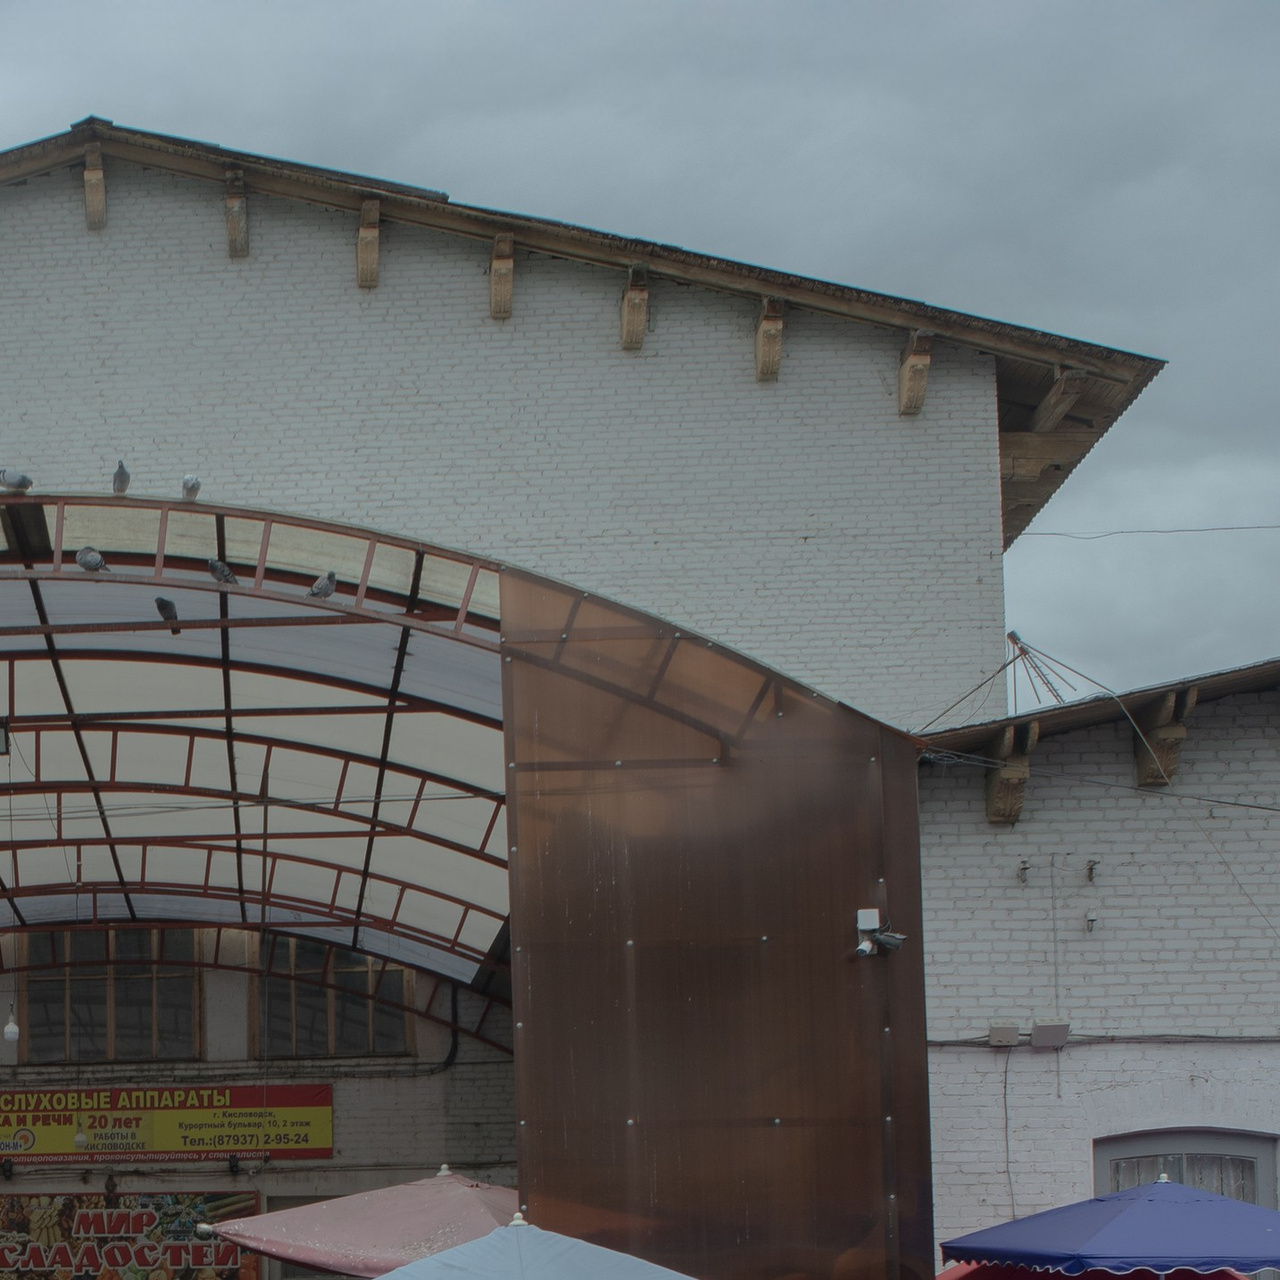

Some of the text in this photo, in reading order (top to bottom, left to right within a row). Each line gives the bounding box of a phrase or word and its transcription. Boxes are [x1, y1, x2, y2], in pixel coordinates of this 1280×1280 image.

[0, 1089, 230, 1111] СЛУХОВЫЕ АППАРАТЫ
[16, 1114, 27, 1126] И
[32, 1113, 73, 1126] РЕЧИ
[222, 1110, 276, 1120] Кисловодск,
[87, 1115, 142, 1129] 20 лет
[178, 1121, 225, 1131] Курортный
[268, 1120, 280, 1128] 10,
[93, 1132, 137, 1141] РАБОТЫ В
[263, 1133, 310, 1145] 2-95-24
[93, 1150, 199, 1162] проконсультируйтесь
[72, 1209, 161, 1237] МИР
